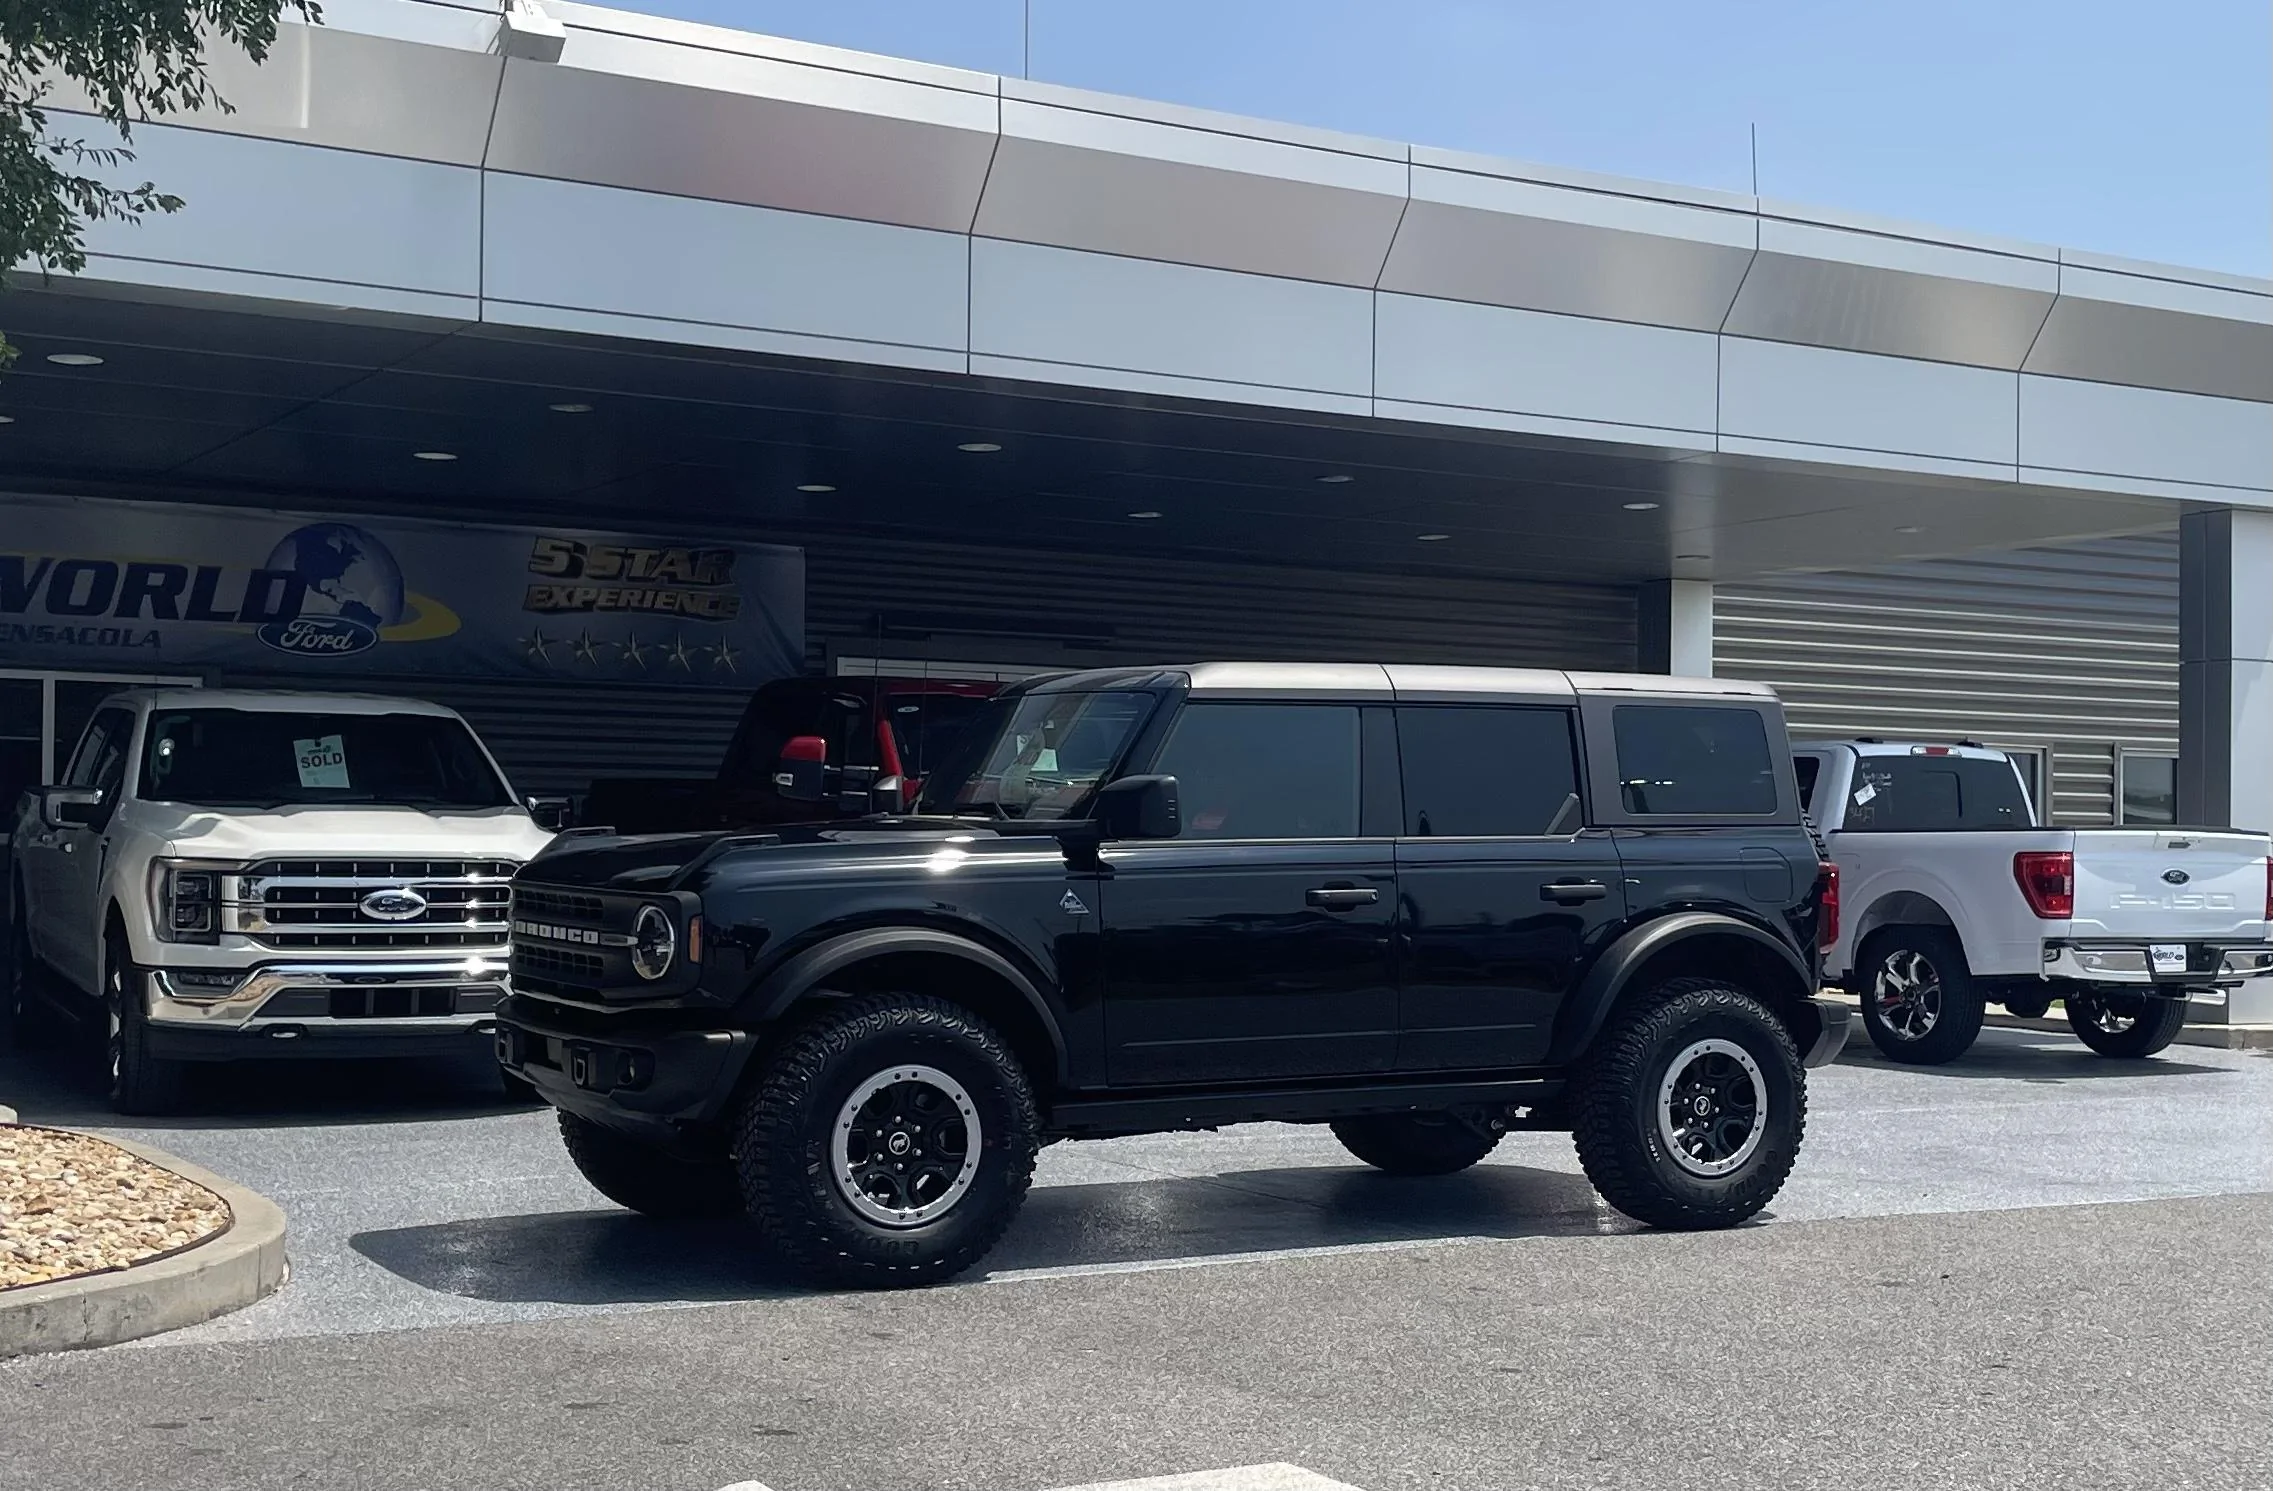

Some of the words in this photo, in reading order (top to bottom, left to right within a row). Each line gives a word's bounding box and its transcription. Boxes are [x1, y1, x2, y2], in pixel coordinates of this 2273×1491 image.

[584, 544, 736, 585] STAR
[522, 584, 740, 621] EXPERIENCE
[280, 617, 355, 651] Ford
[300, 752, 343, 769] SOLD
[2109, 892, 2236, 911] F-150
[514, 920, 599, 944] BRONCO
